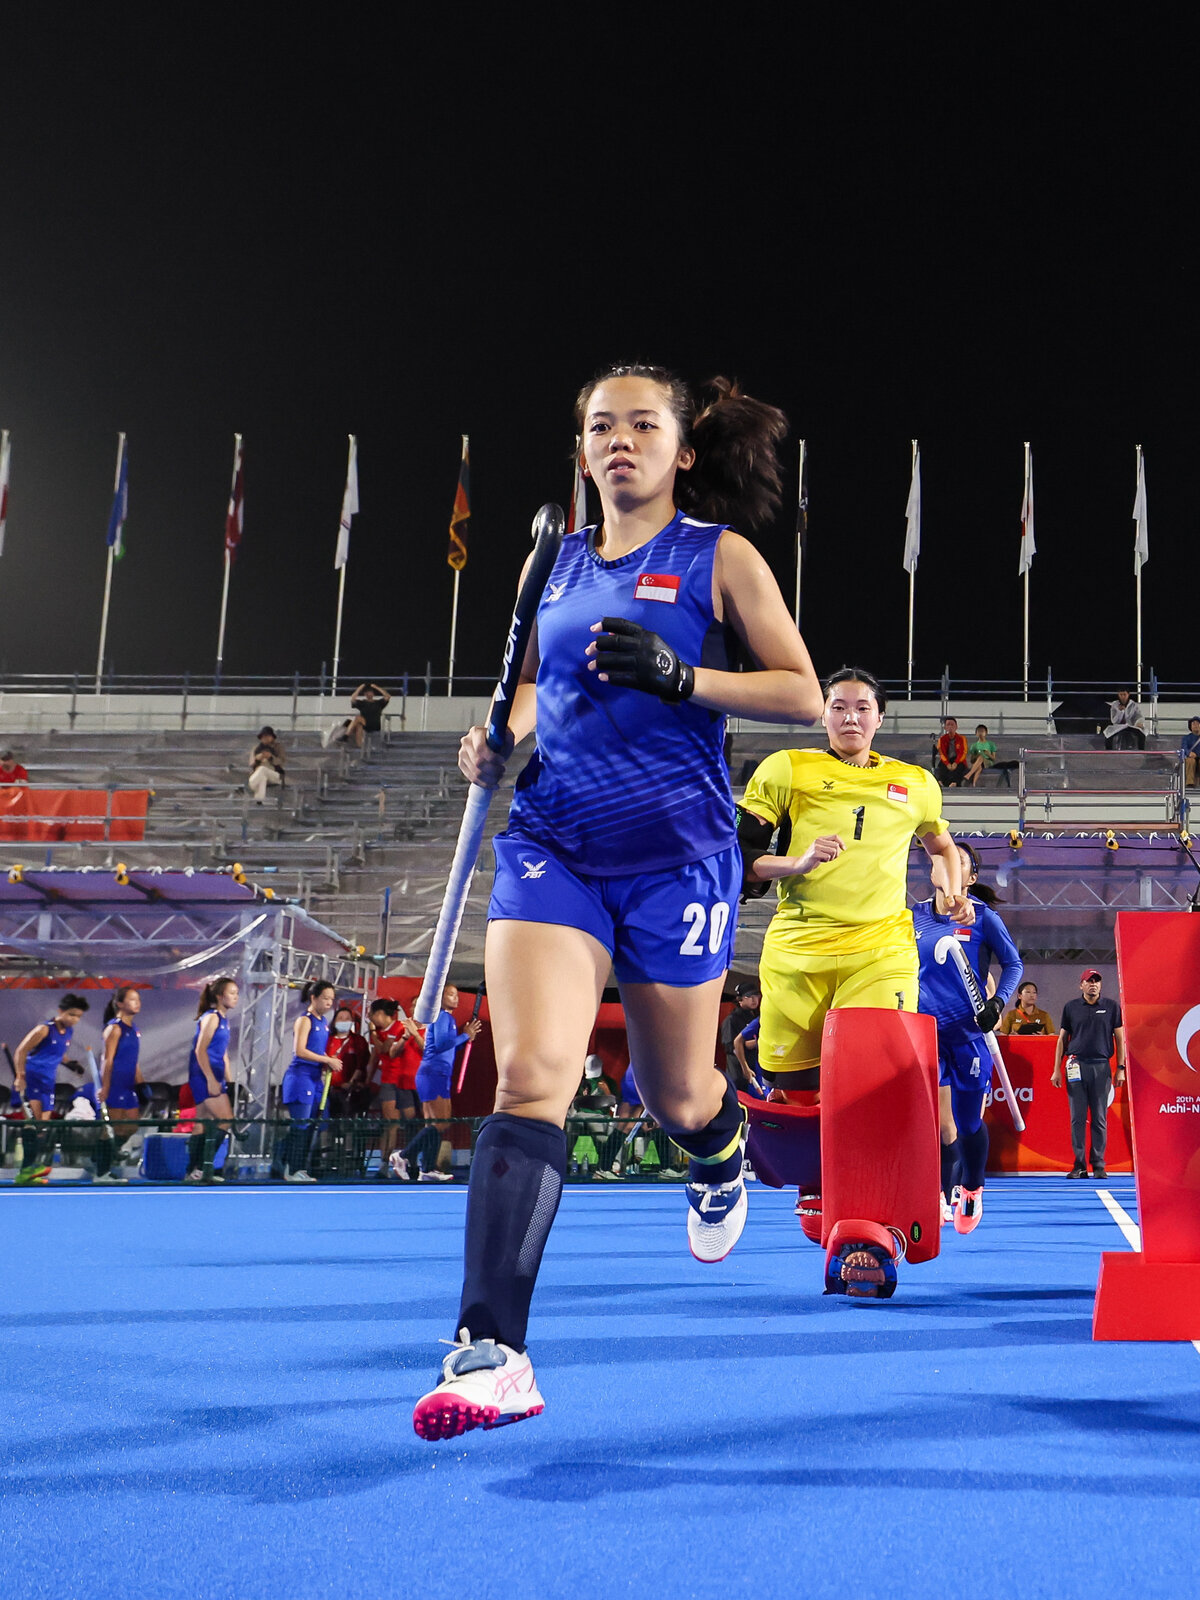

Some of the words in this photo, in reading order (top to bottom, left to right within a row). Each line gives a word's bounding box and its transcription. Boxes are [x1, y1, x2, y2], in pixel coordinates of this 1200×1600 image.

[852, 805, 865, 841] 1
[680, 902, 730, 956] 20
[970, 1057, 981, 1078] 4
